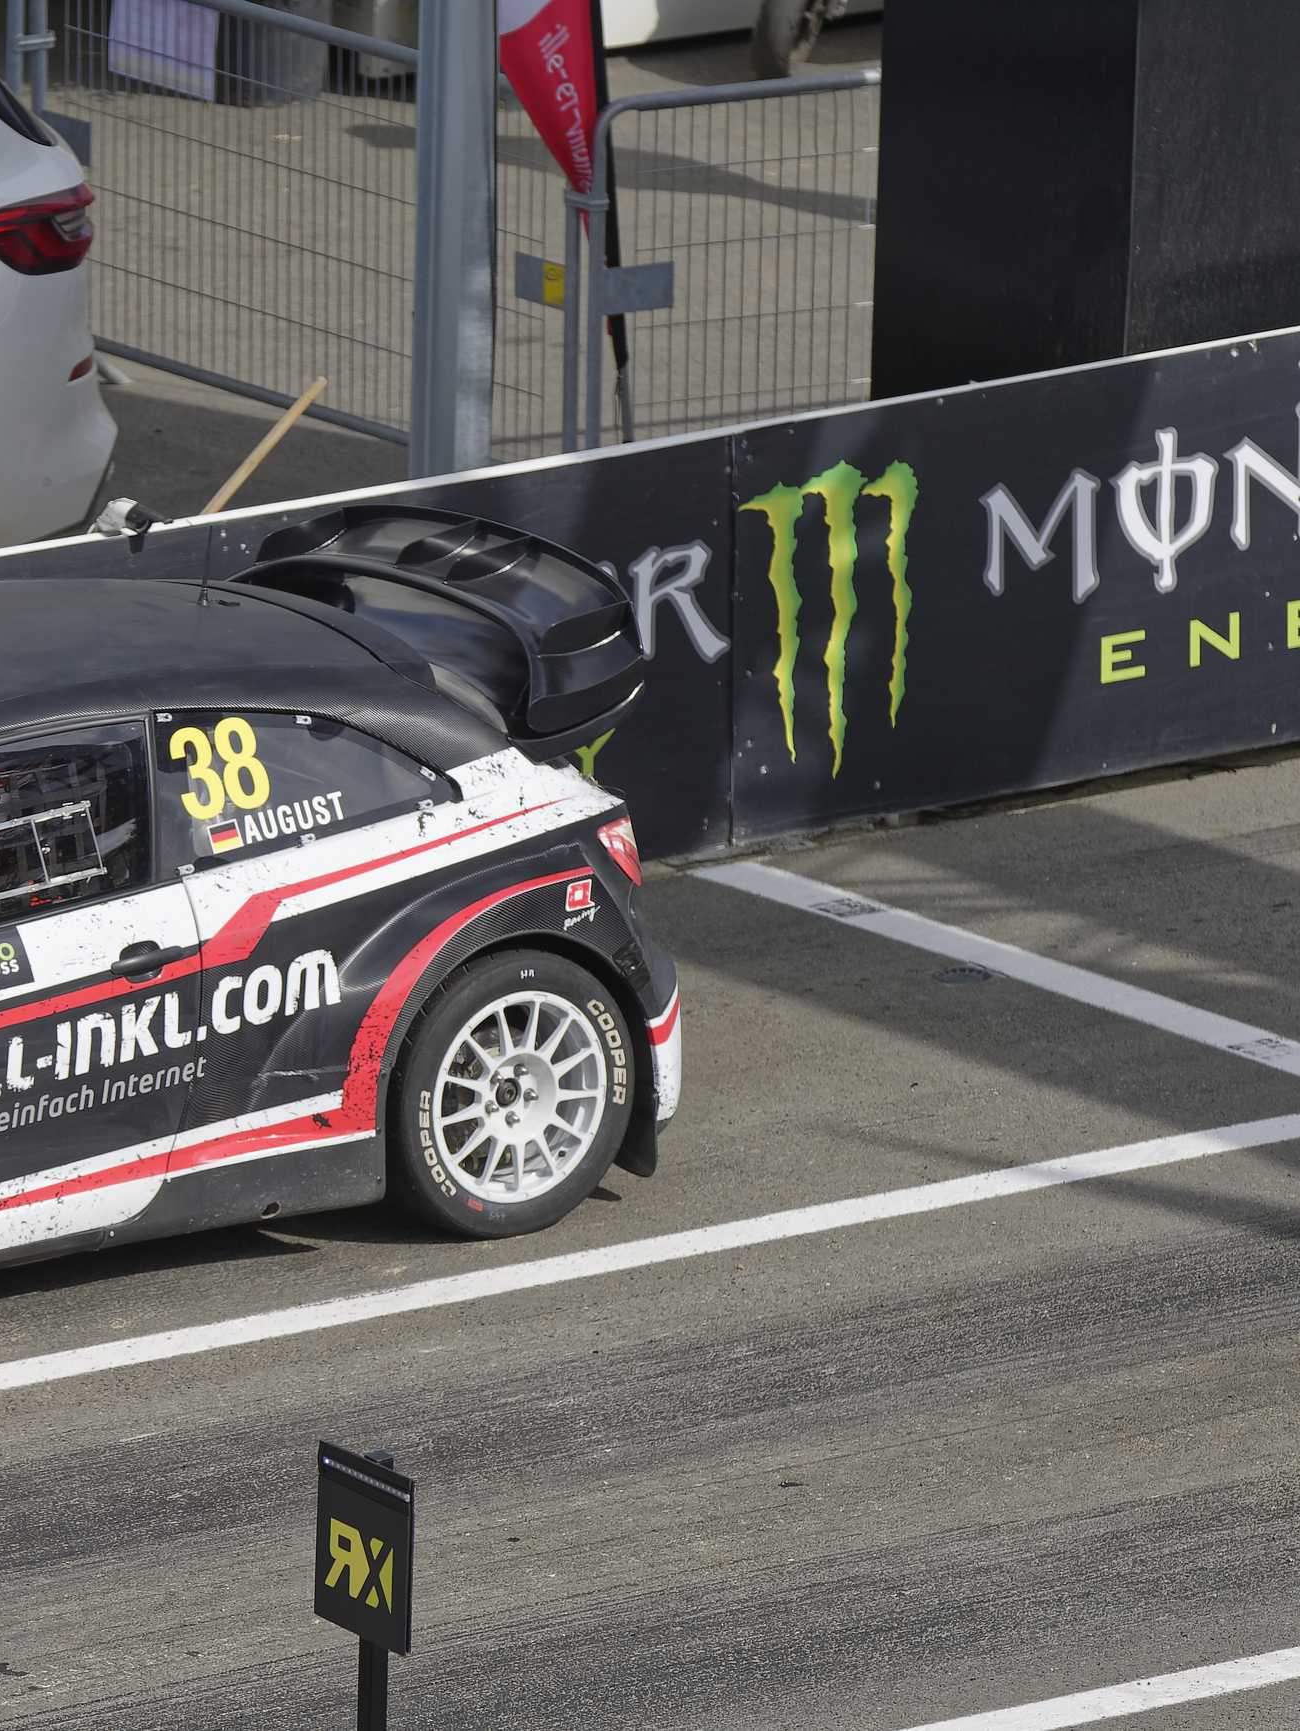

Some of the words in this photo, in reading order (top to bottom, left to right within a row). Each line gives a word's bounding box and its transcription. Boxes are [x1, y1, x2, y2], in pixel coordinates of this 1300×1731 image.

[169, 716, 270, 820] 38
[243, 791, 345, 844] AUGUST
[101, 1055, 208, 1105] Internet
[586, 998, 627, 1105] COOPER
[419, 1089, 457, 1198] COOPER
